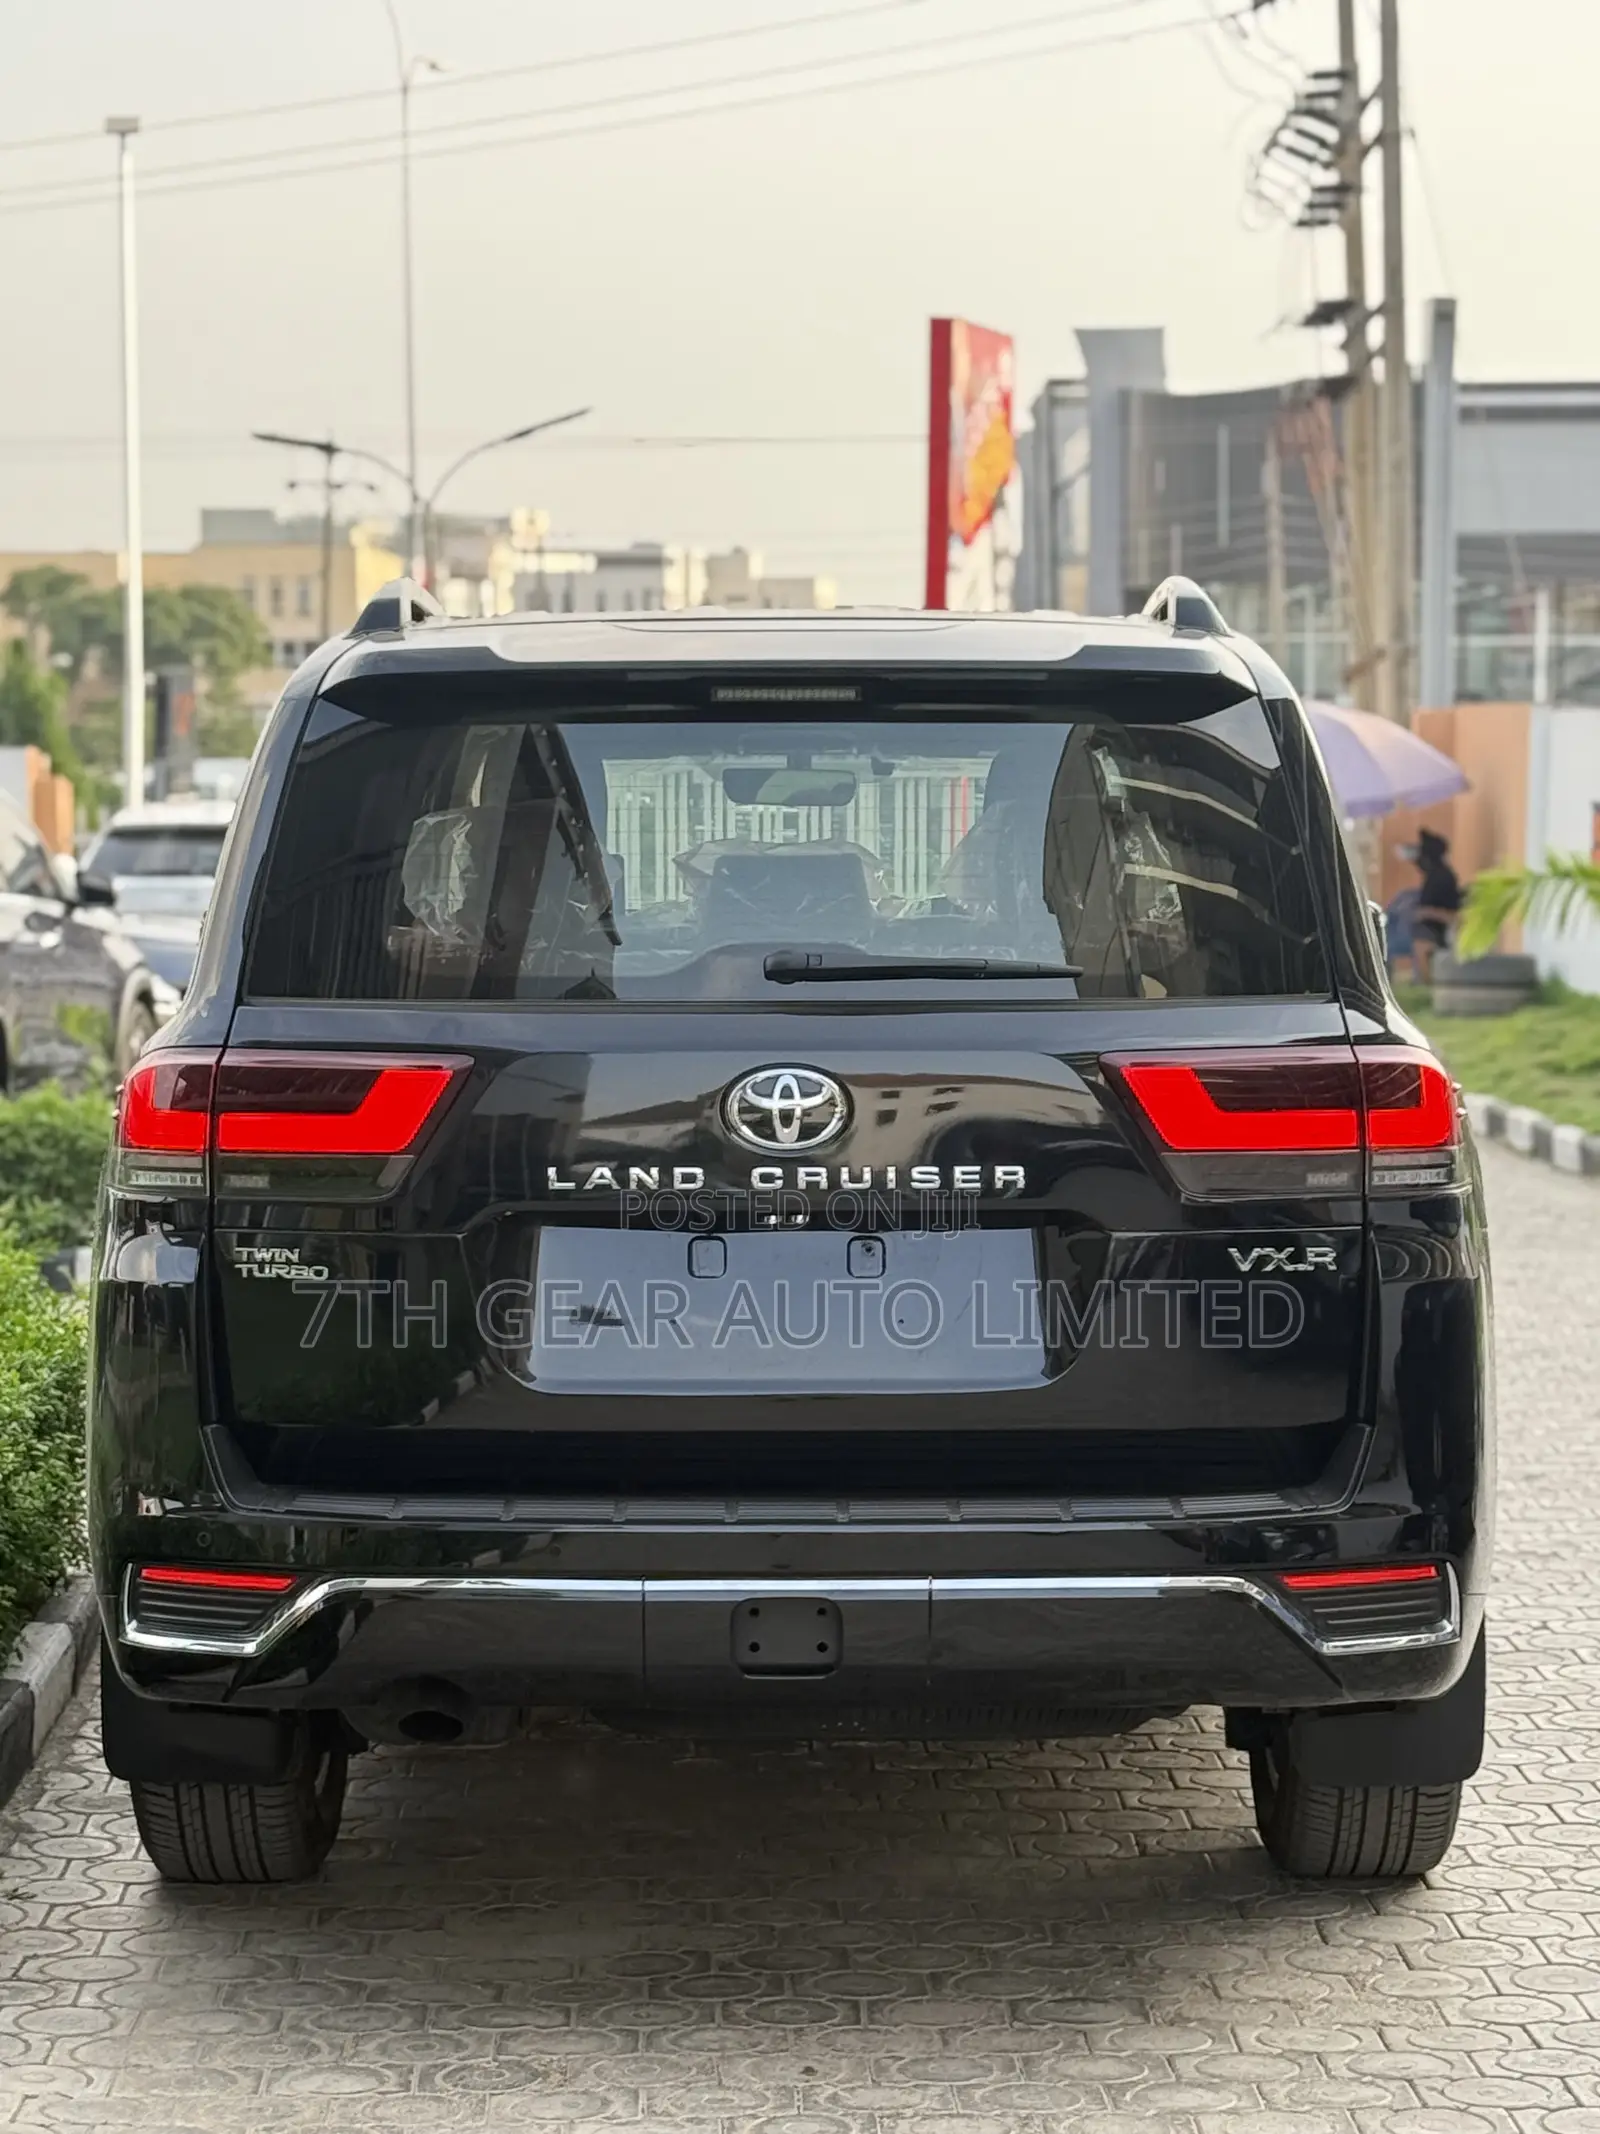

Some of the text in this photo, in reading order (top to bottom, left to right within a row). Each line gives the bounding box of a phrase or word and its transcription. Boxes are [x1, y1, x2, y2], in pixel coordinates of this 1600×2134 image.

[546, 1165, 1027, 1191] LAND CRUISER
[235, 1247, 300, 1262] TWIN
[235, 1264, 329, 1281] TURBO
